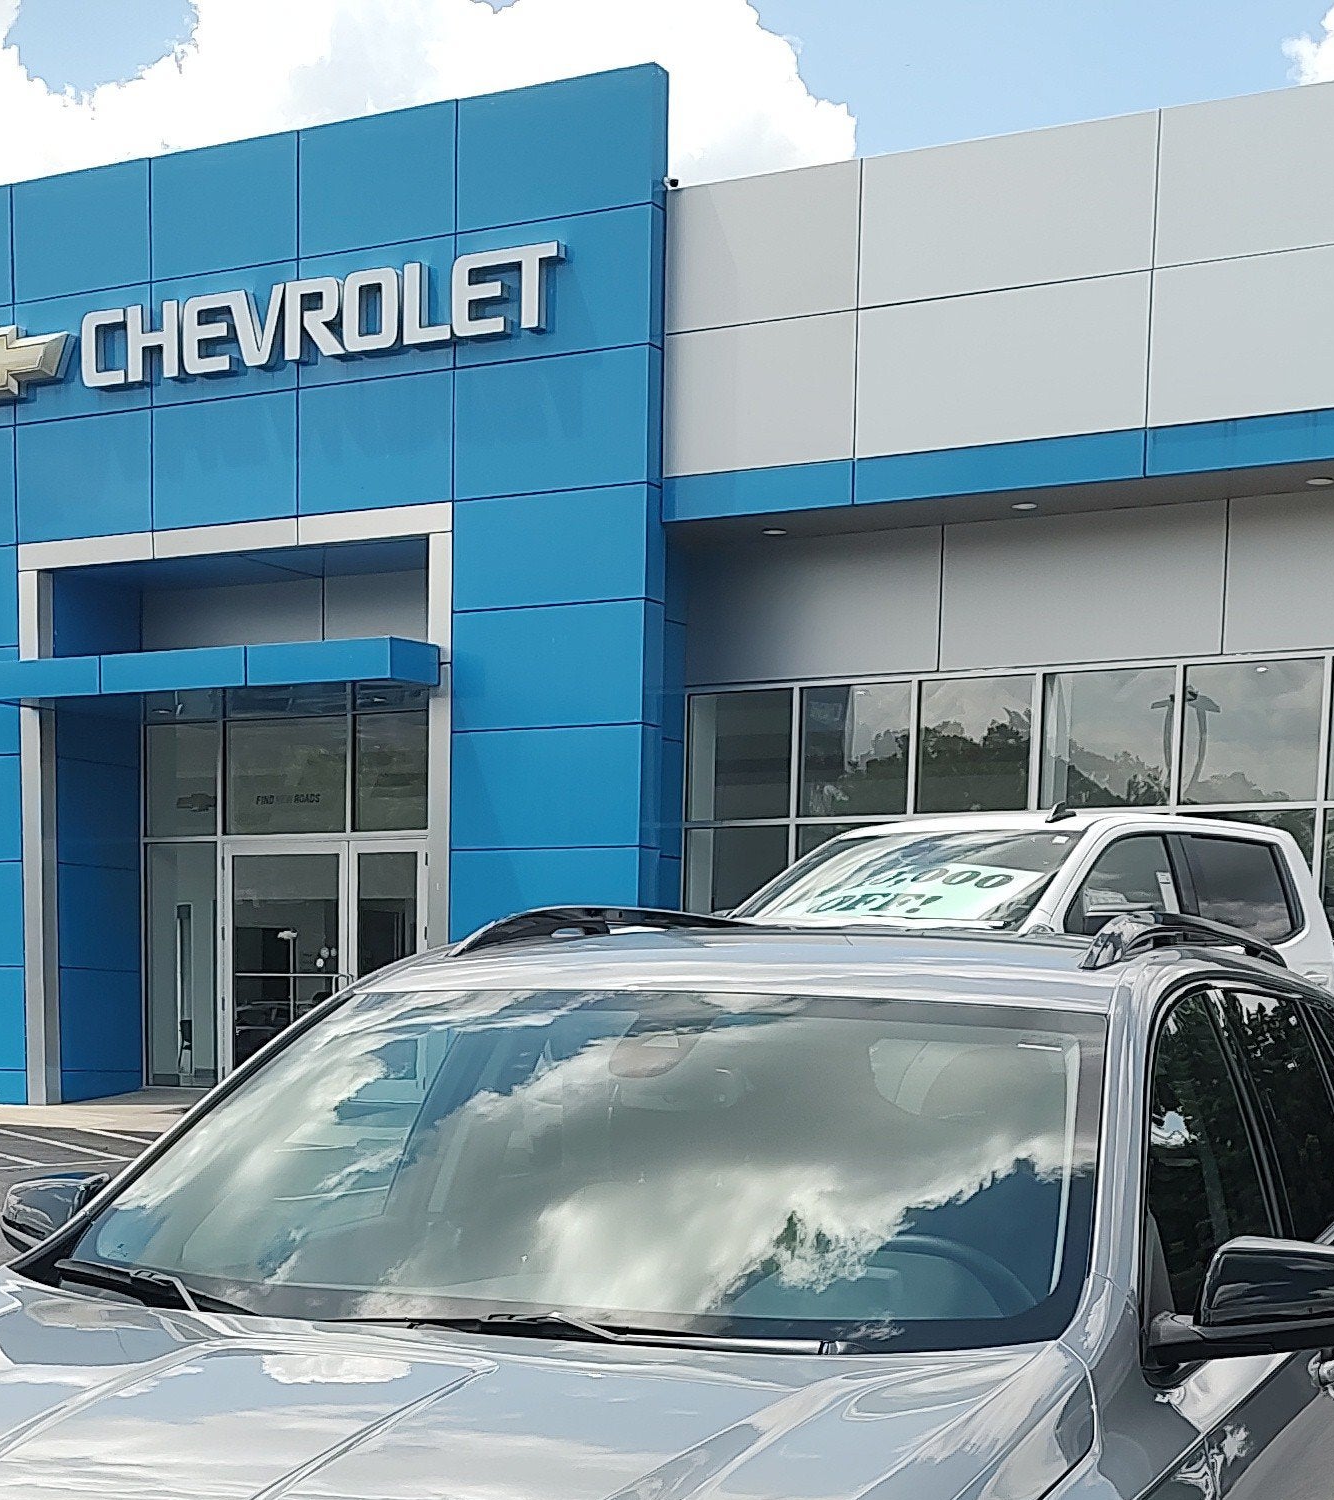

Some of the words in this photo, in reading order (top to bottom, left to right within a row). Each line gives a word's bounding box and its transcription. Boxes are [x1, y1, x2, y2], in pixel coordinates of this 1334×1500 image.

[80, 240, 566, 390] CHEVROLET
[256, 795, 275, 806] FIND
[293, 793, 321, 804] ROADS
